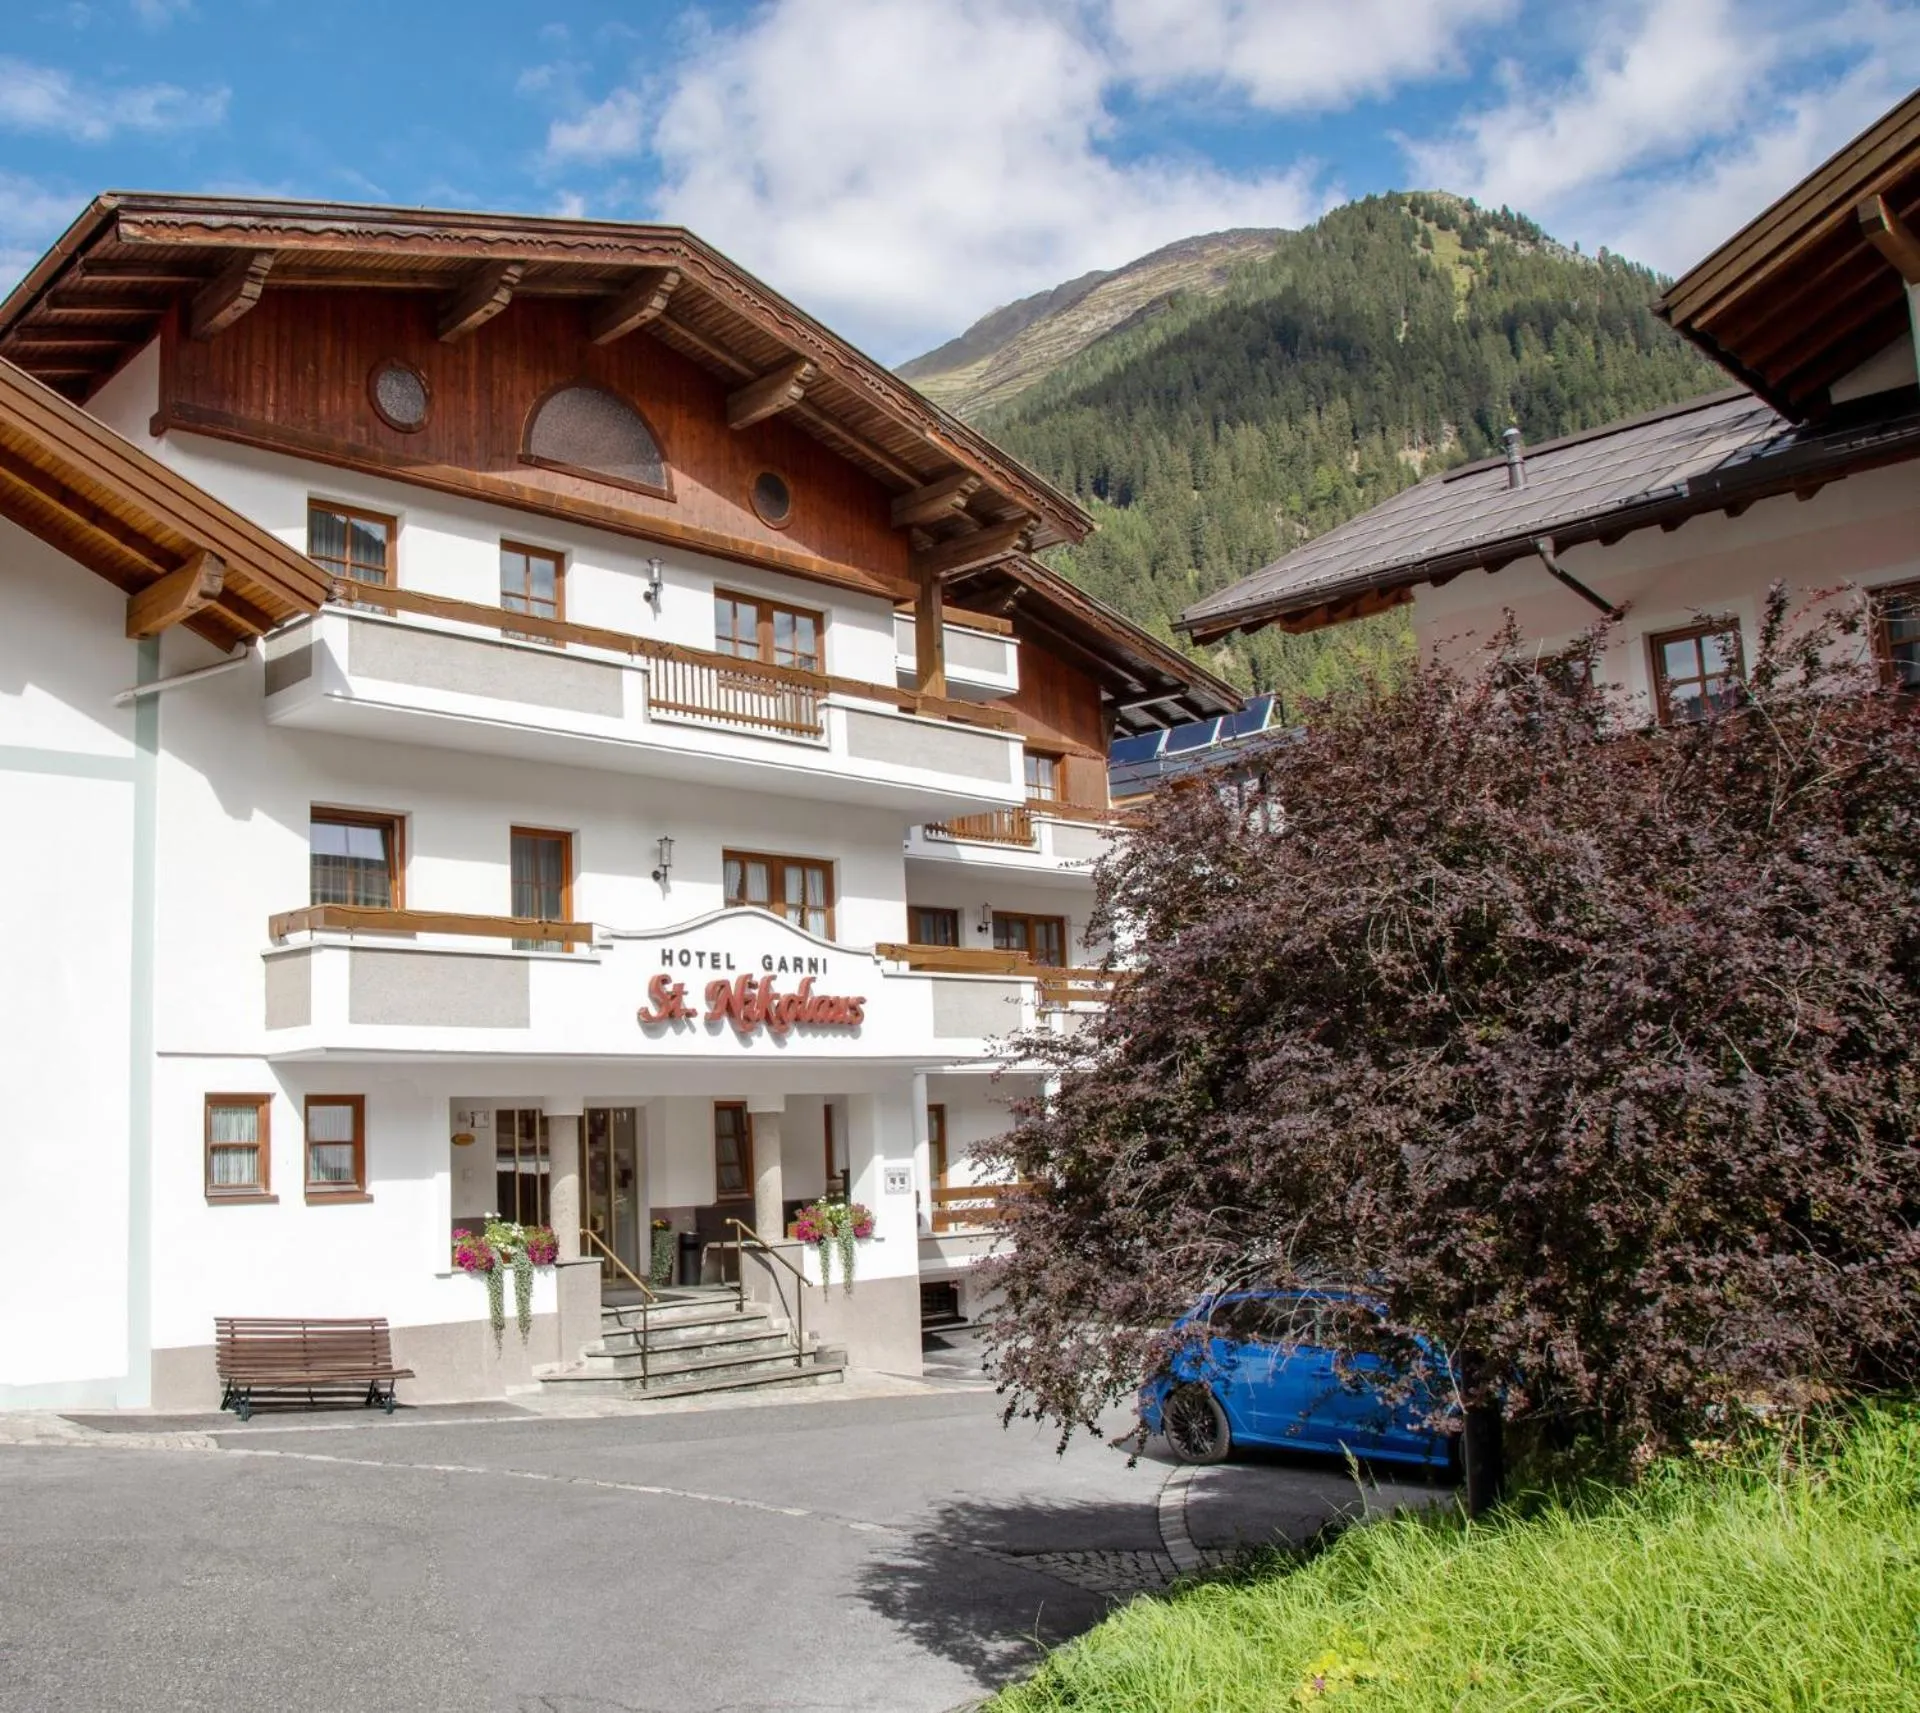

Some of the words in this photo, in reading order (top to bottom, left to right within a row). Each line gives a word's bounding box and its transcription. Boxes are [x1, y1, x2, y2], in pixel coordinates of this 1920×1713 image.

[661, 948, 736, 970] HOTEL
[761, 954, 828, 974] GARNI
[637, 973, 698, 1024] St.
[704, 973, 867, 1034] Nikolaus
